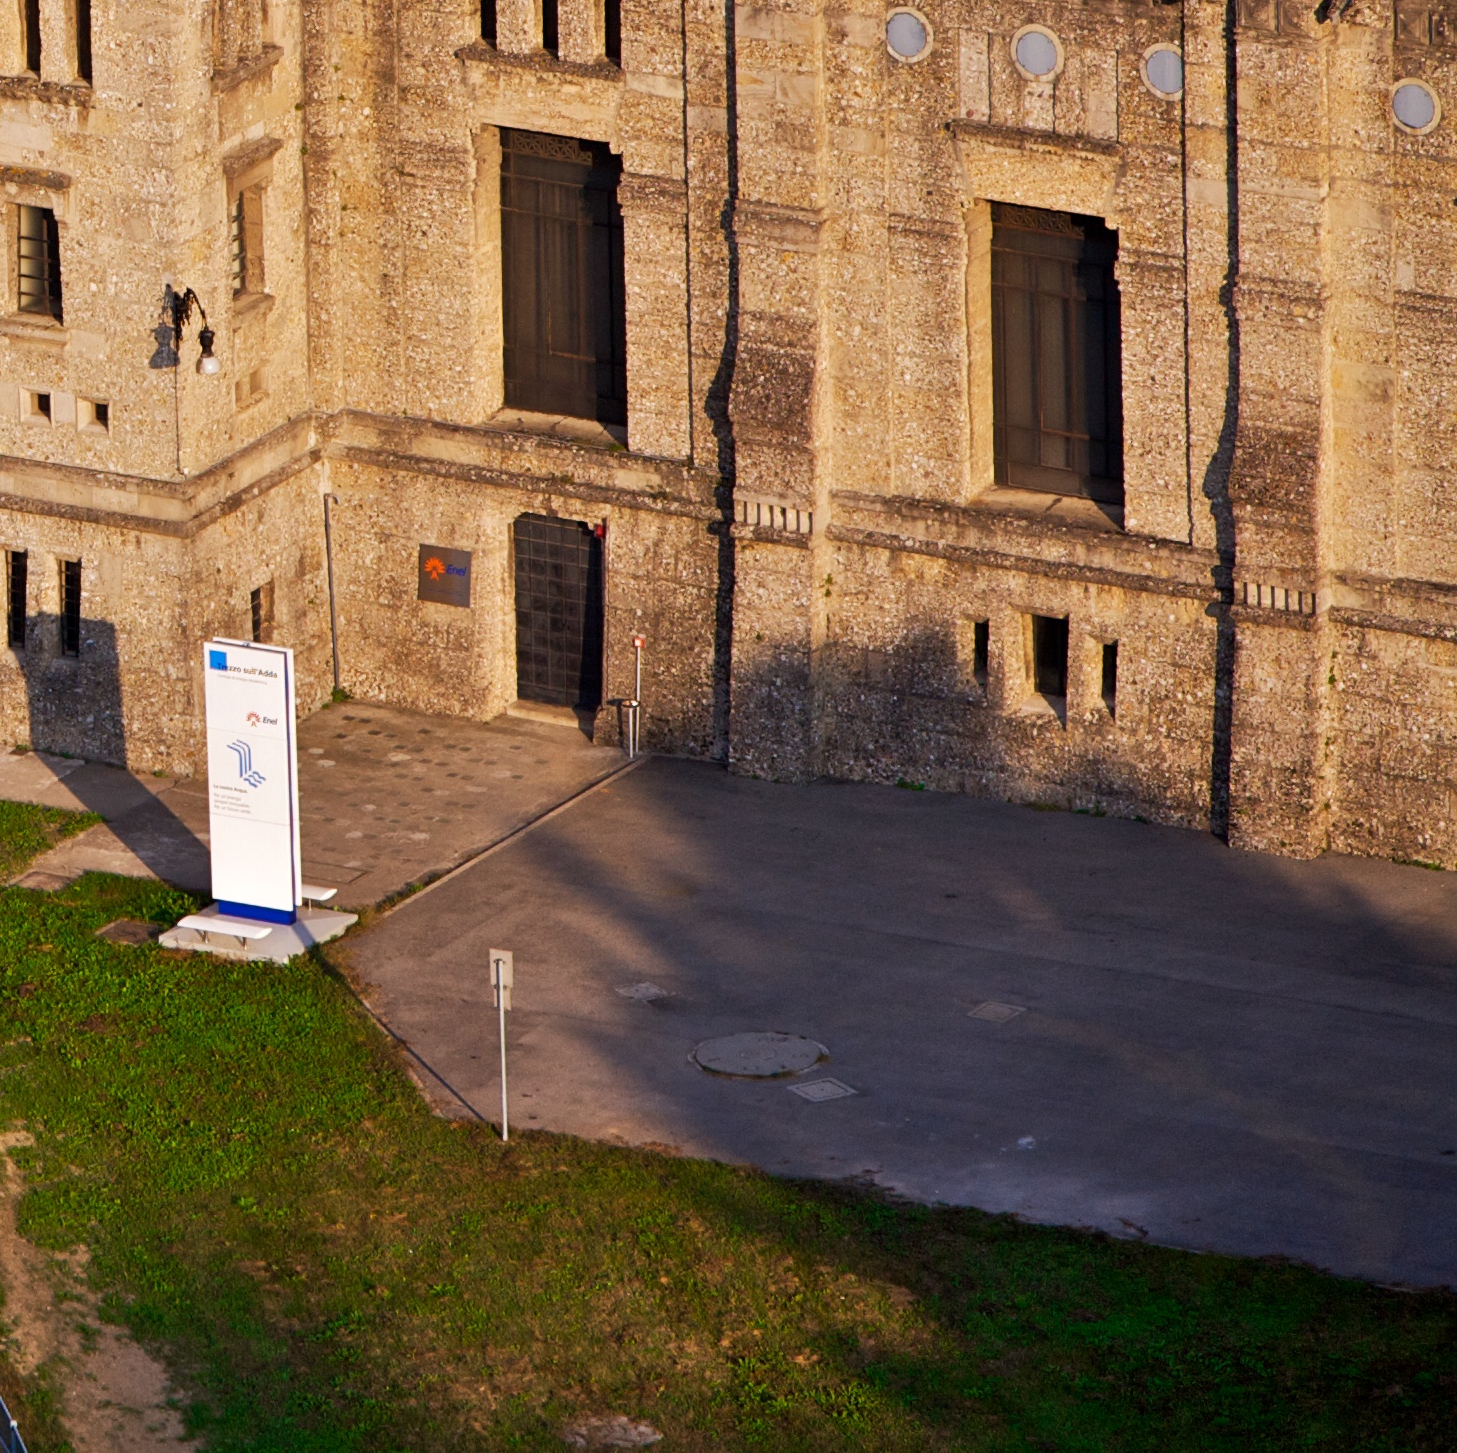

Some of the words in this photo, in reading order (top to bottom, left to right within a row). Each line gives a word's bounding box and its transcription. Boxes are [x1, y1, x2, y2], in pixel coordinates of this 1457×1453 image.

[446, 564, 467, 576] Enel
[217, 662, 242, 674] Trezzo
[262, 716, 278, 726] Enel
